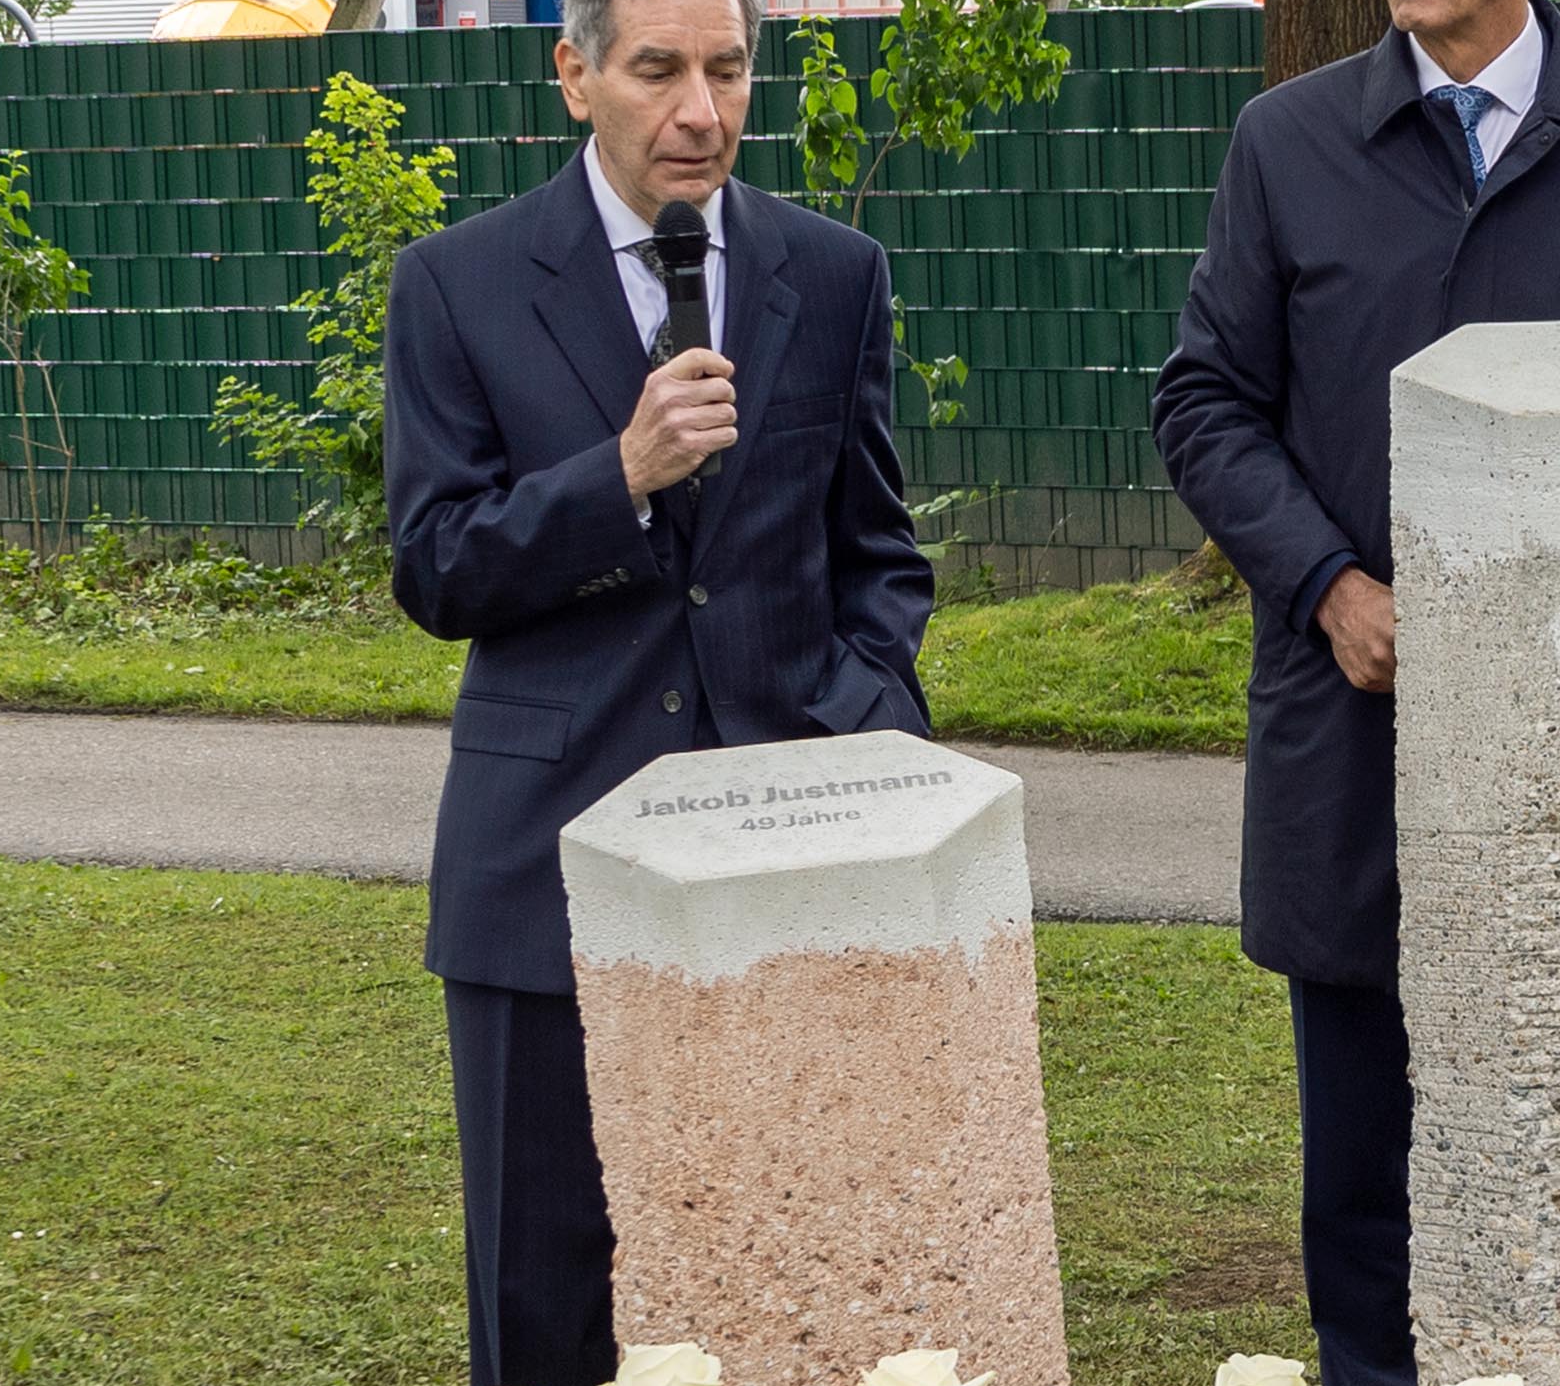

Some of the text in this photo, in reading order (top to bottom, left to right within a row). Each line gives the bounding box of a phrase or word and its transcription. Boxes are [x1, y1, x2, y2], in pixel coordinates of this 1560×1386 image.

[635, 770, 953, 818] Jakob Justmann
[741, 810, 861, 830] 49 Jahre
